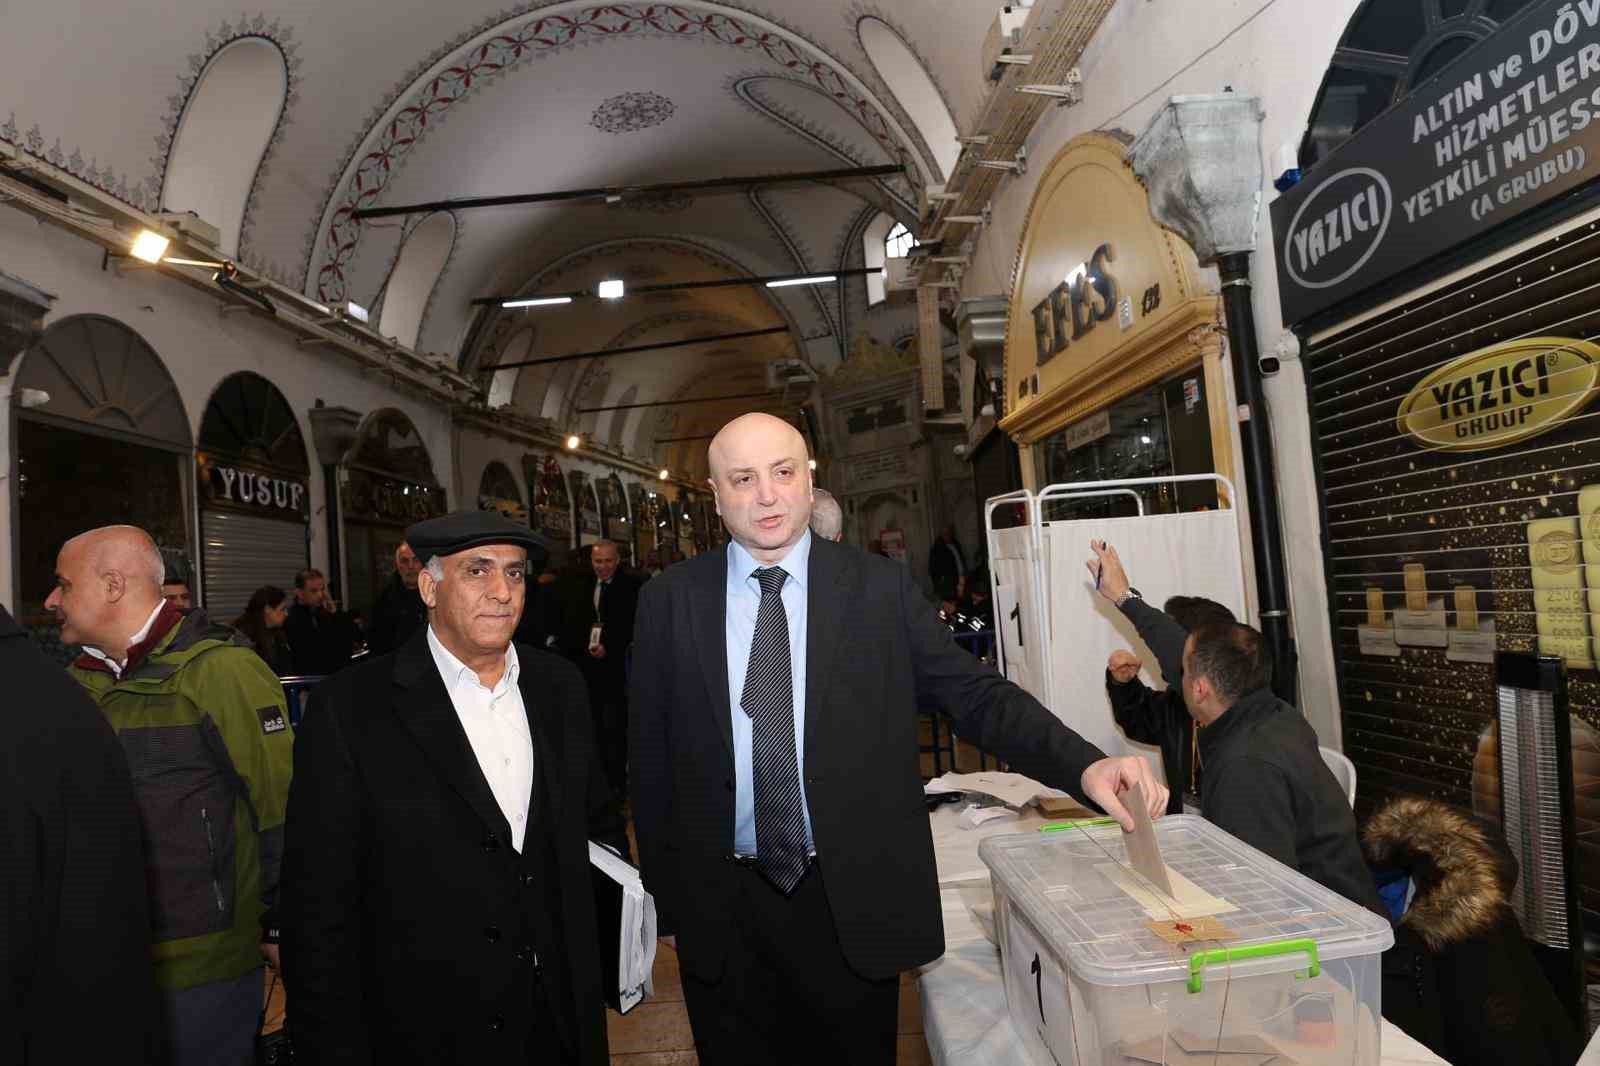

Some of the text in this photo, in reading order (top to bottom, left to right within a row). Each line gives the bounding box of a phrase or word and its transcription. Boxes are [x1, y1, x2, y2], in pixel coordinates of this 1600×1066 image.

[1412, 73, 1484, 144] ALTIN
[1489, 54, 1522, 88] ve
[1402, 144, 1498, 223] YETKİLİ
[1470, 146, 1585, 221] (A GRUBU)
[1294, 185, 1380, 273] YAZICI
[1031, 241, 1117, 367] EFES
[1455, 406, 1533, 438] GROUP
[217, 466, 304, 510] YUSUF
[1010, 602, 1024, 646] 1
[1031, 952, 1047, 1027] 1
